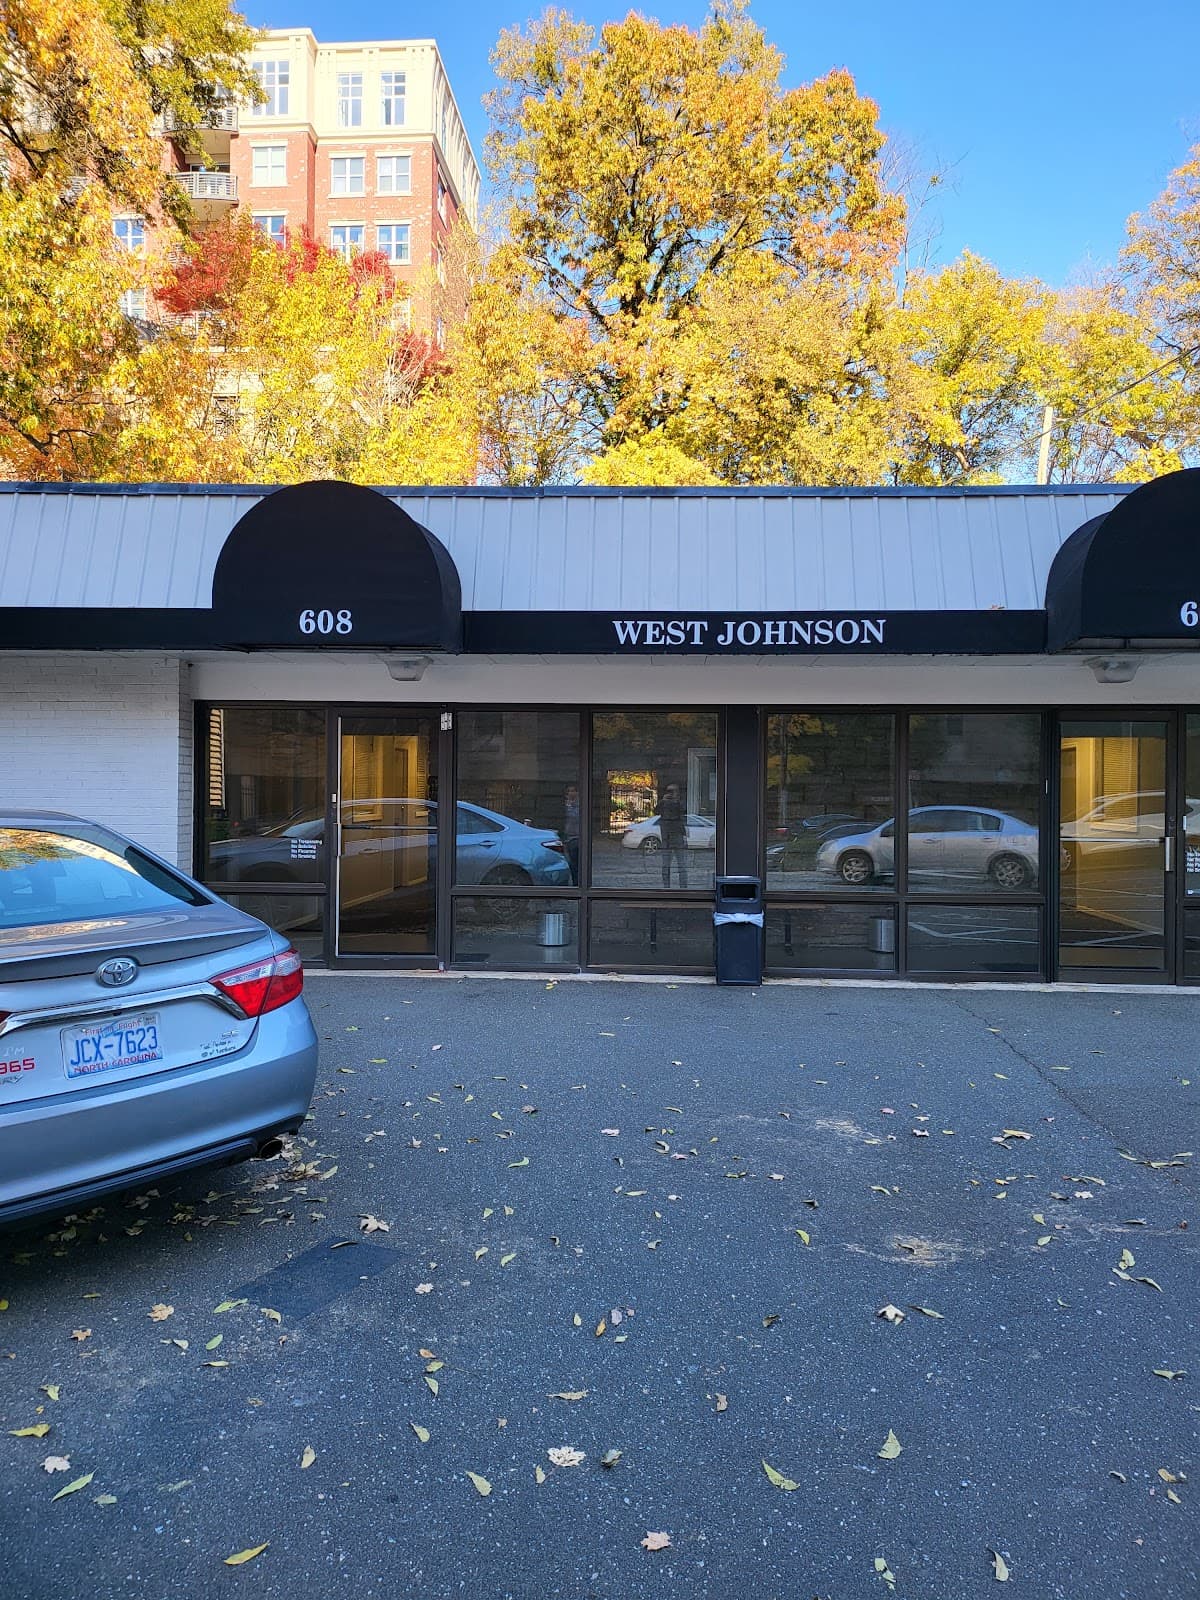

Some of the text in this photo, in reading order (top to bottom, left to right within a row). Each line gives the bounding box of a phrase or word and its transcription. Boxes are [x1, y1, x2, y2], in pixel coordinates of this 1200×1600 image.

[299, 609, 353, 634] 608
[1180, 601, 1198, 626] 6
[612, 619, 887, 646] WEST JOHNSON
[70, 1026, 158, 1066] JCX-7623
[74, 1051, 158, 1074] NORTH CAROLINA
